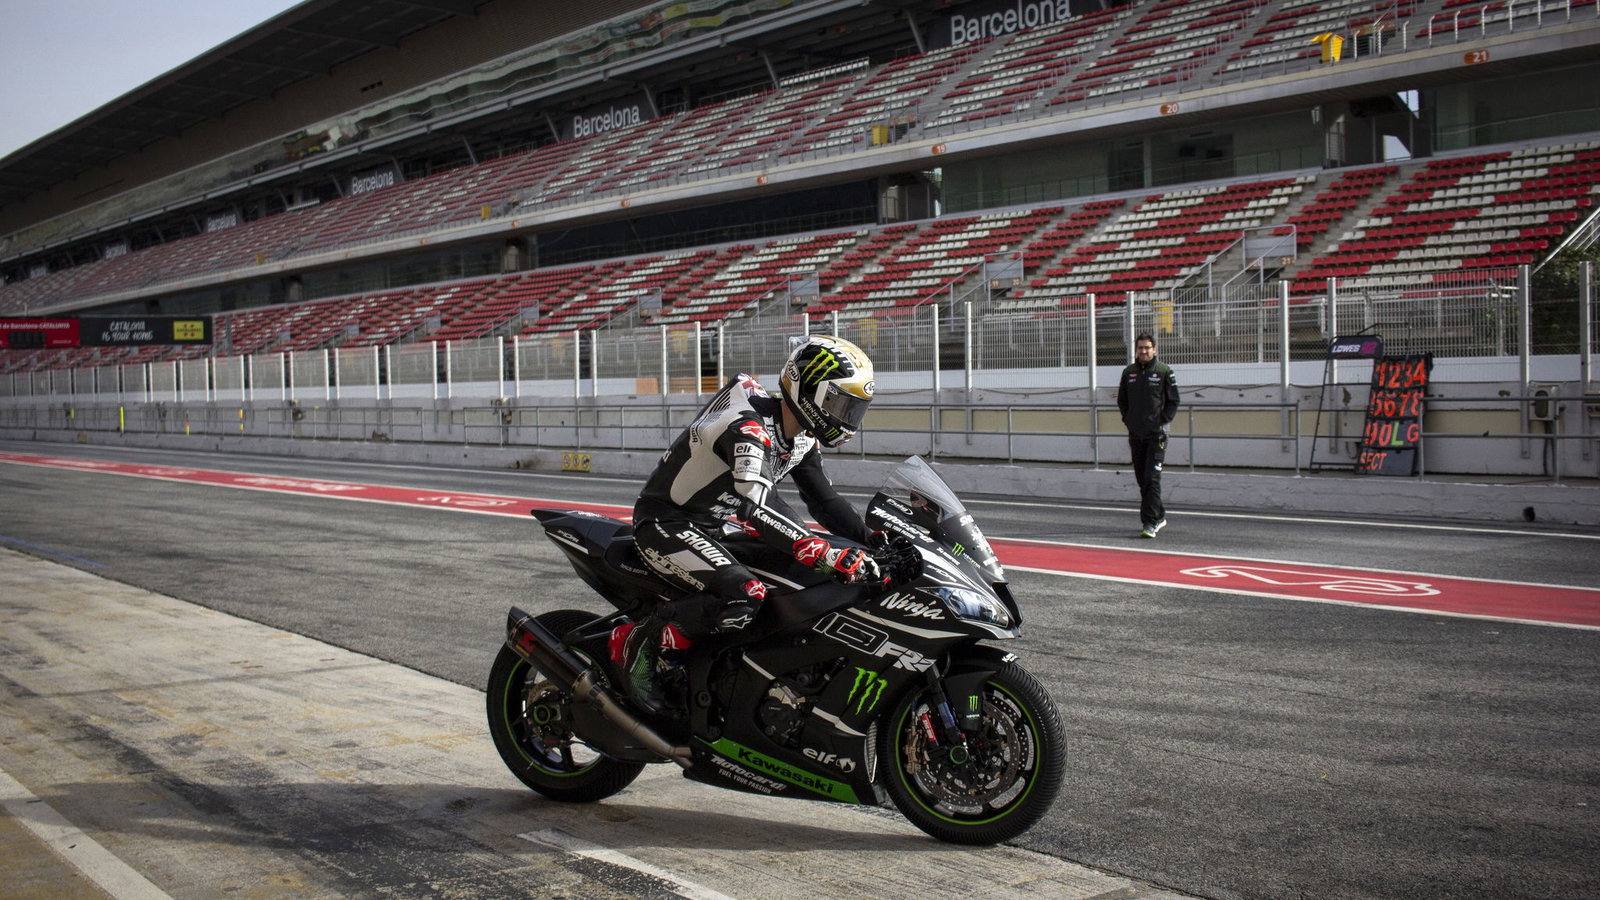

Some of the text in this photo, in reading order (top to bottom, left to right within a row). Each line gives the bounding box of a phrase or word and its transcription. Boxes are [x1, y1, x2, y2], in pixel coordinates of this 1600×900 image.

[951, 0, 1072, 46] Barcelona
[1473, 50, 1487, 63] 21
[573, 105, 641, 139] Barcelona
[1166, 103, 1178, 114] 20
[352, 169, 394, 195] Barcelona
[1332, 344, 1361, 353] LOWES
[735, 445, 753, 454] elf
[753, 508, 804, 541] Kawasaki
[676, 530, 732, 567] SHOWA
[645, 547, 706, 592] alpinestars
[879, 592, 946, 620] Ninja
[738, 747, 834, 794] Kawasaki
[802, 747, 838, 766] elf
